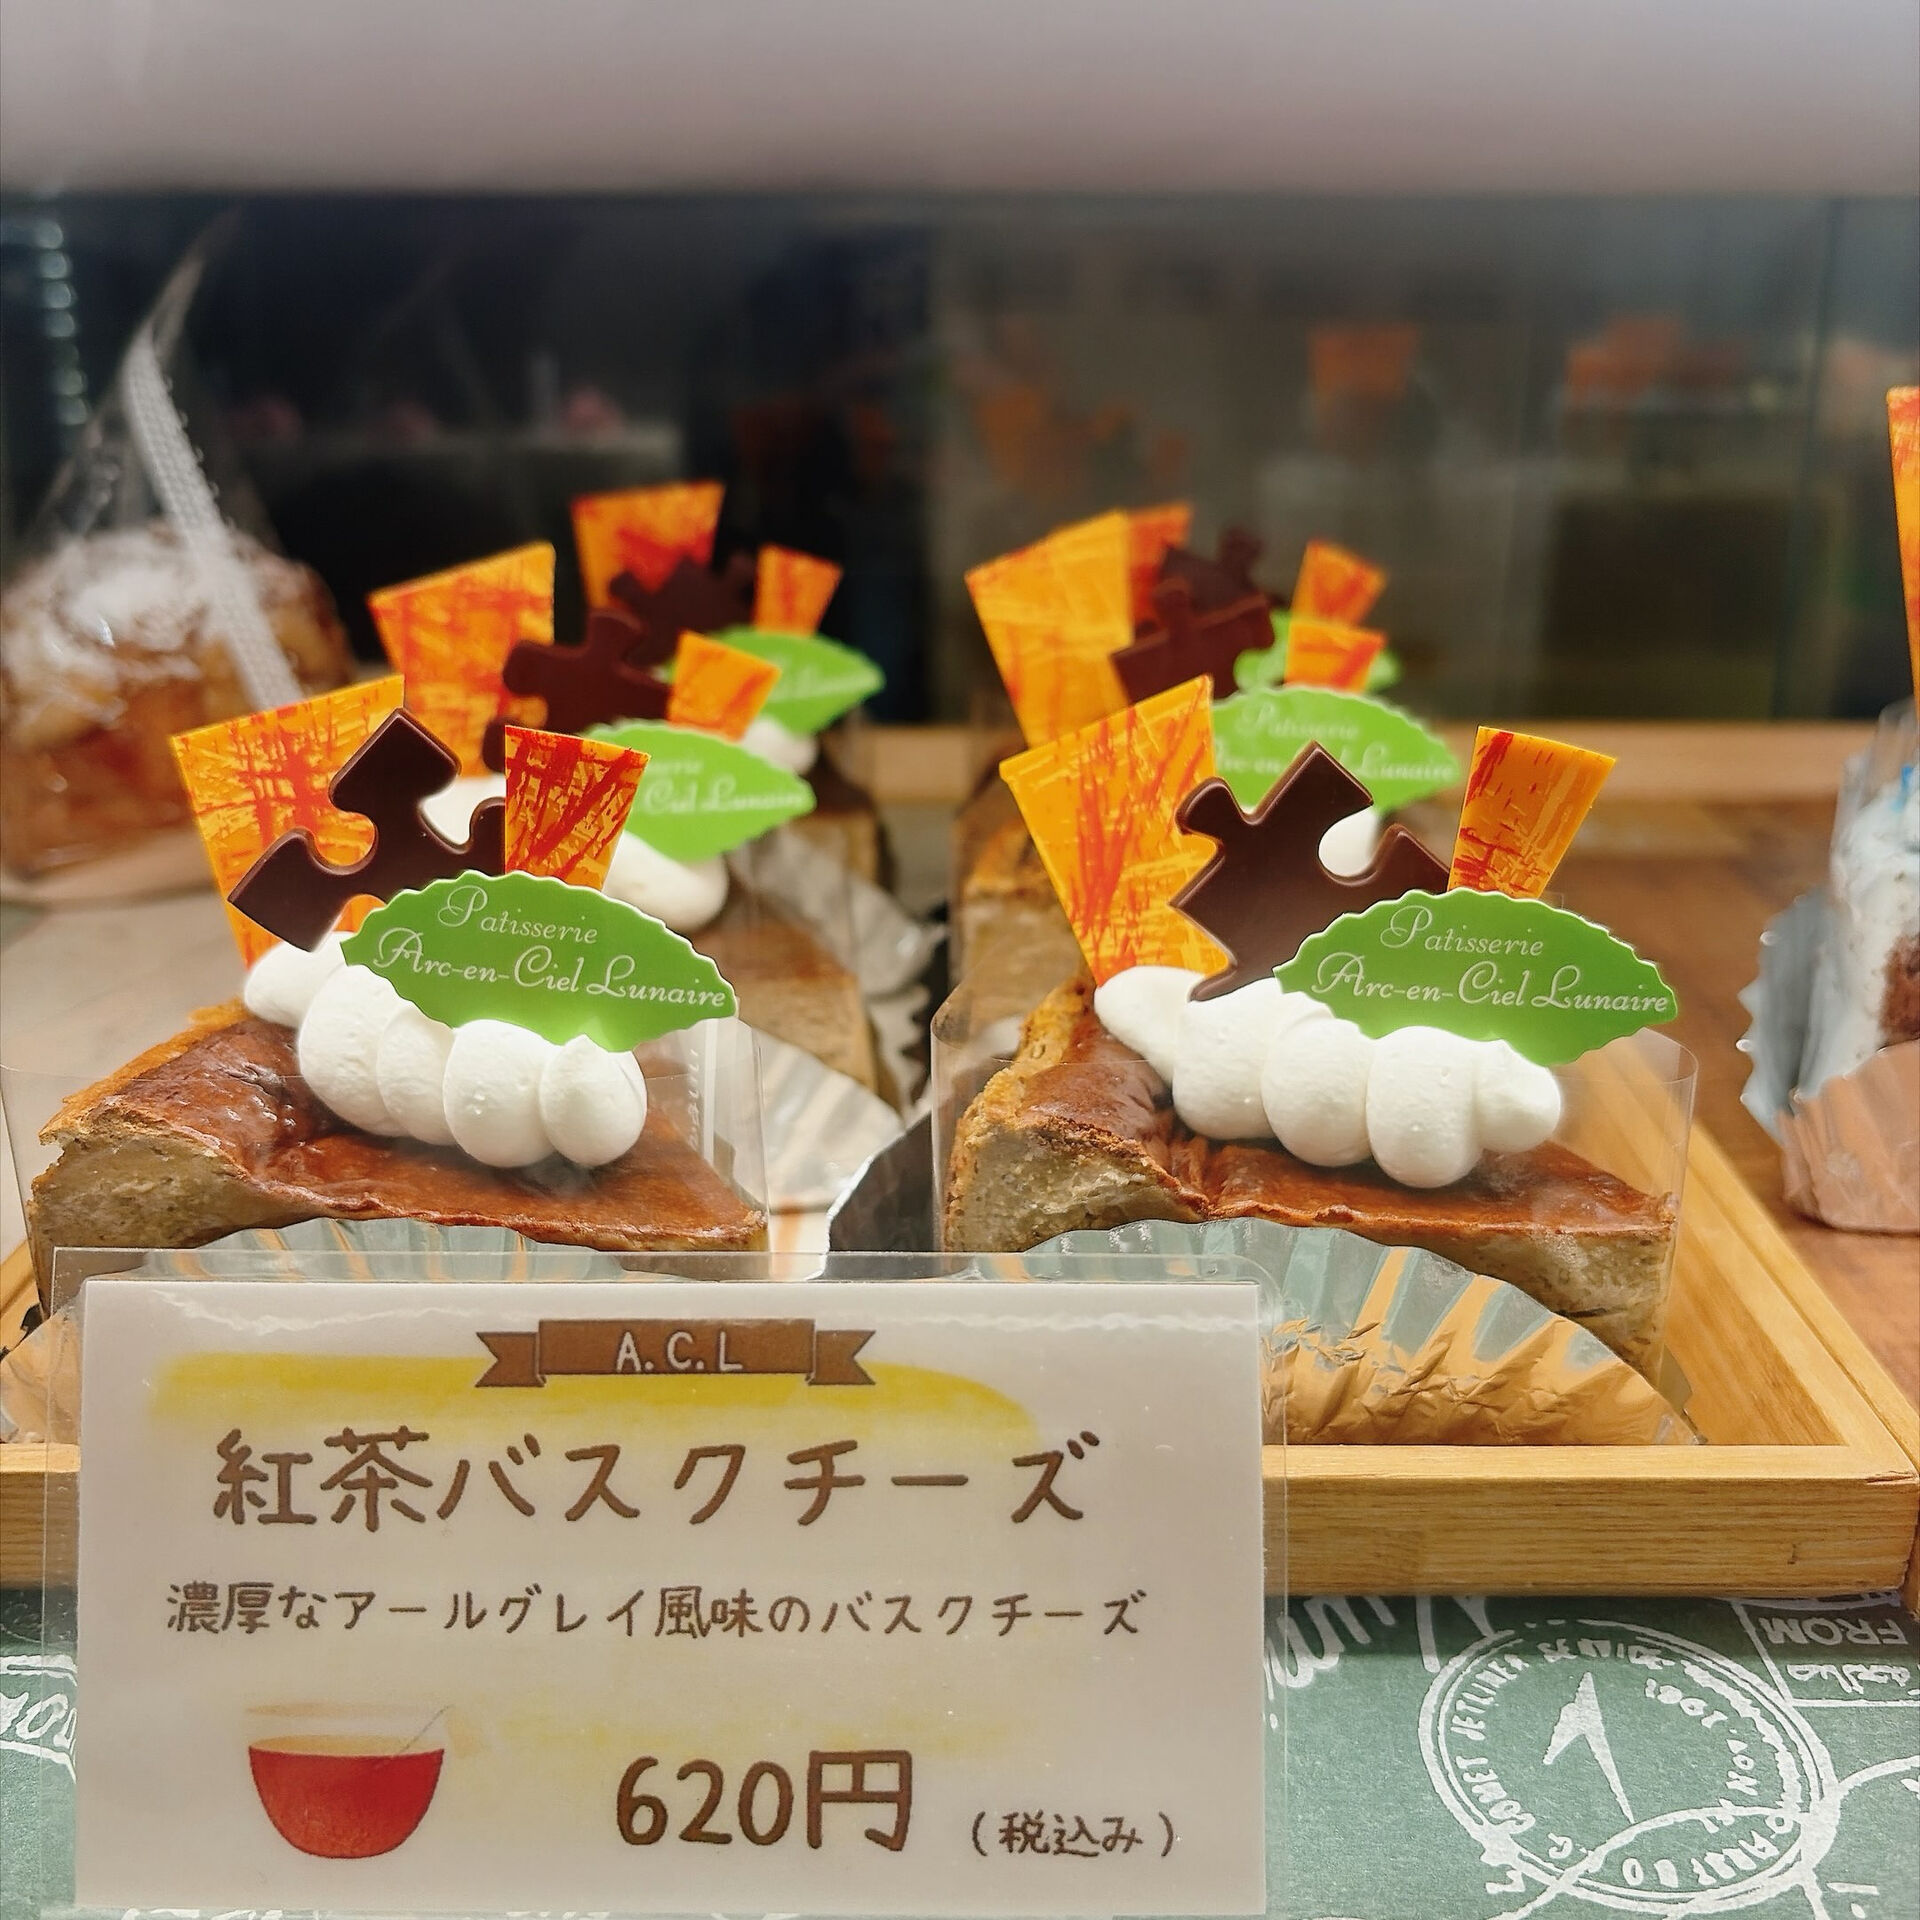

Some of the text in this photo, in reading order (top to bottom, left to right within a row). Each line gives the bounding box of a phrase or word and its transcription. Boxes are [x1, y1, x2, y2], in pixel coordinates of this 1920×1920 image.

[437, 884, 598, 944] Patisserie
[1379, 904, 1544, 957] Patisserie
[373, 926, 726, 1007] Arc-en-Ciel Lunaire
[1311, 951, 1668, 1012] Arc-en-Ciel Lunaire
[615, 1331, 743, 1372] A.C.L
[213, 1425, 1101, 1533] 紅茶バスクチーズ
[166, 1581, 1148, 1639] 濃厚なアールグレイ風味のバスクチーズ
[1758, 1616, 1908, 1646] FROM
[616, 1749, 1175, 1858] 620円 (税込み)
